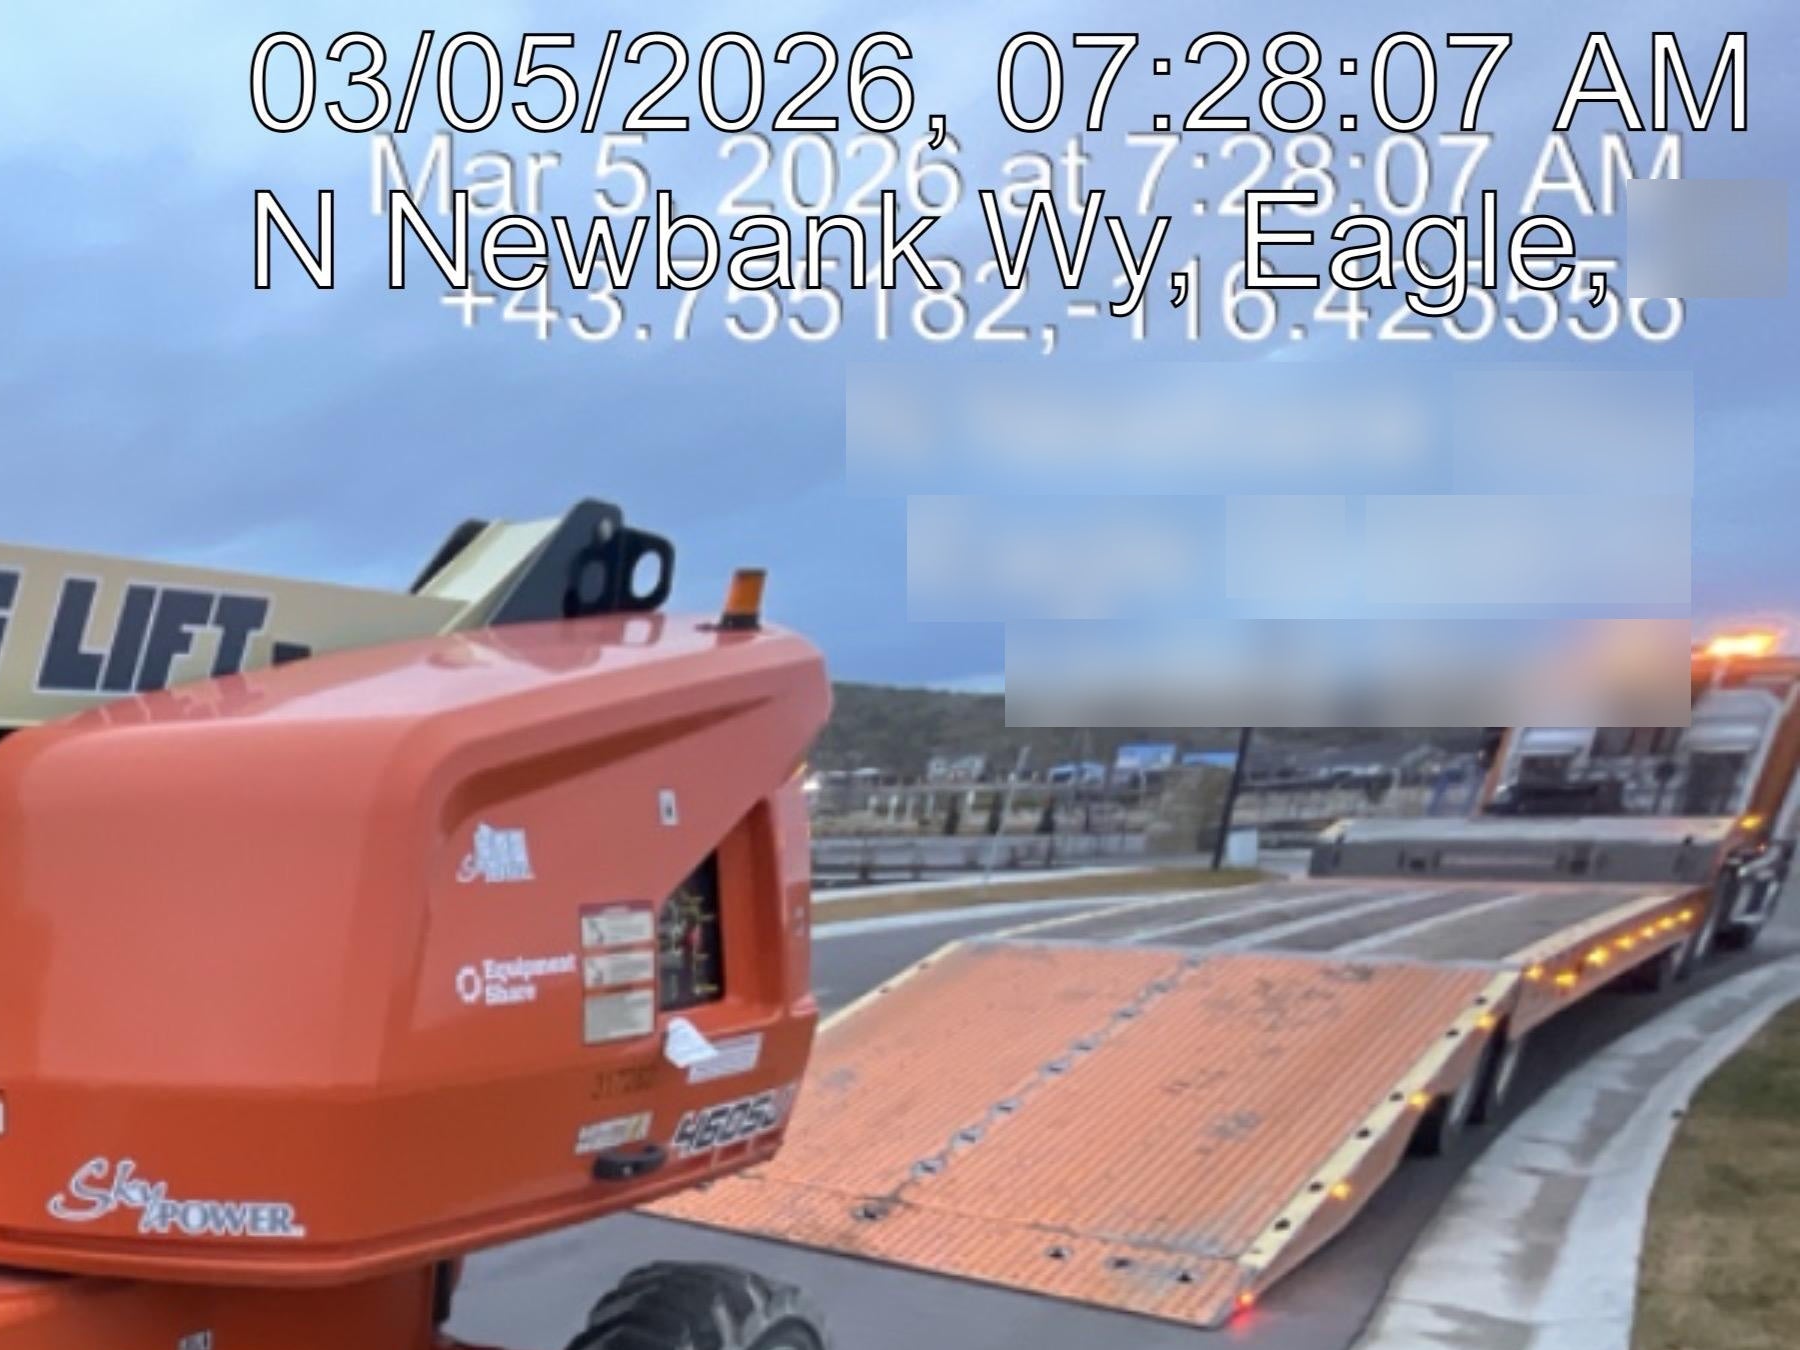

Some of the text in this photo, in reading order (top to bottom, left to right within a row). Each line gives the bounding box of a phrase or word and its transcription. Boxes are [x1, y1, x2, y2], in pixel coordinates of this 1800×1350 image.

[34, 575, 272, 694] LIFT
[47, 1157, 306, 1238] Sky POWER
